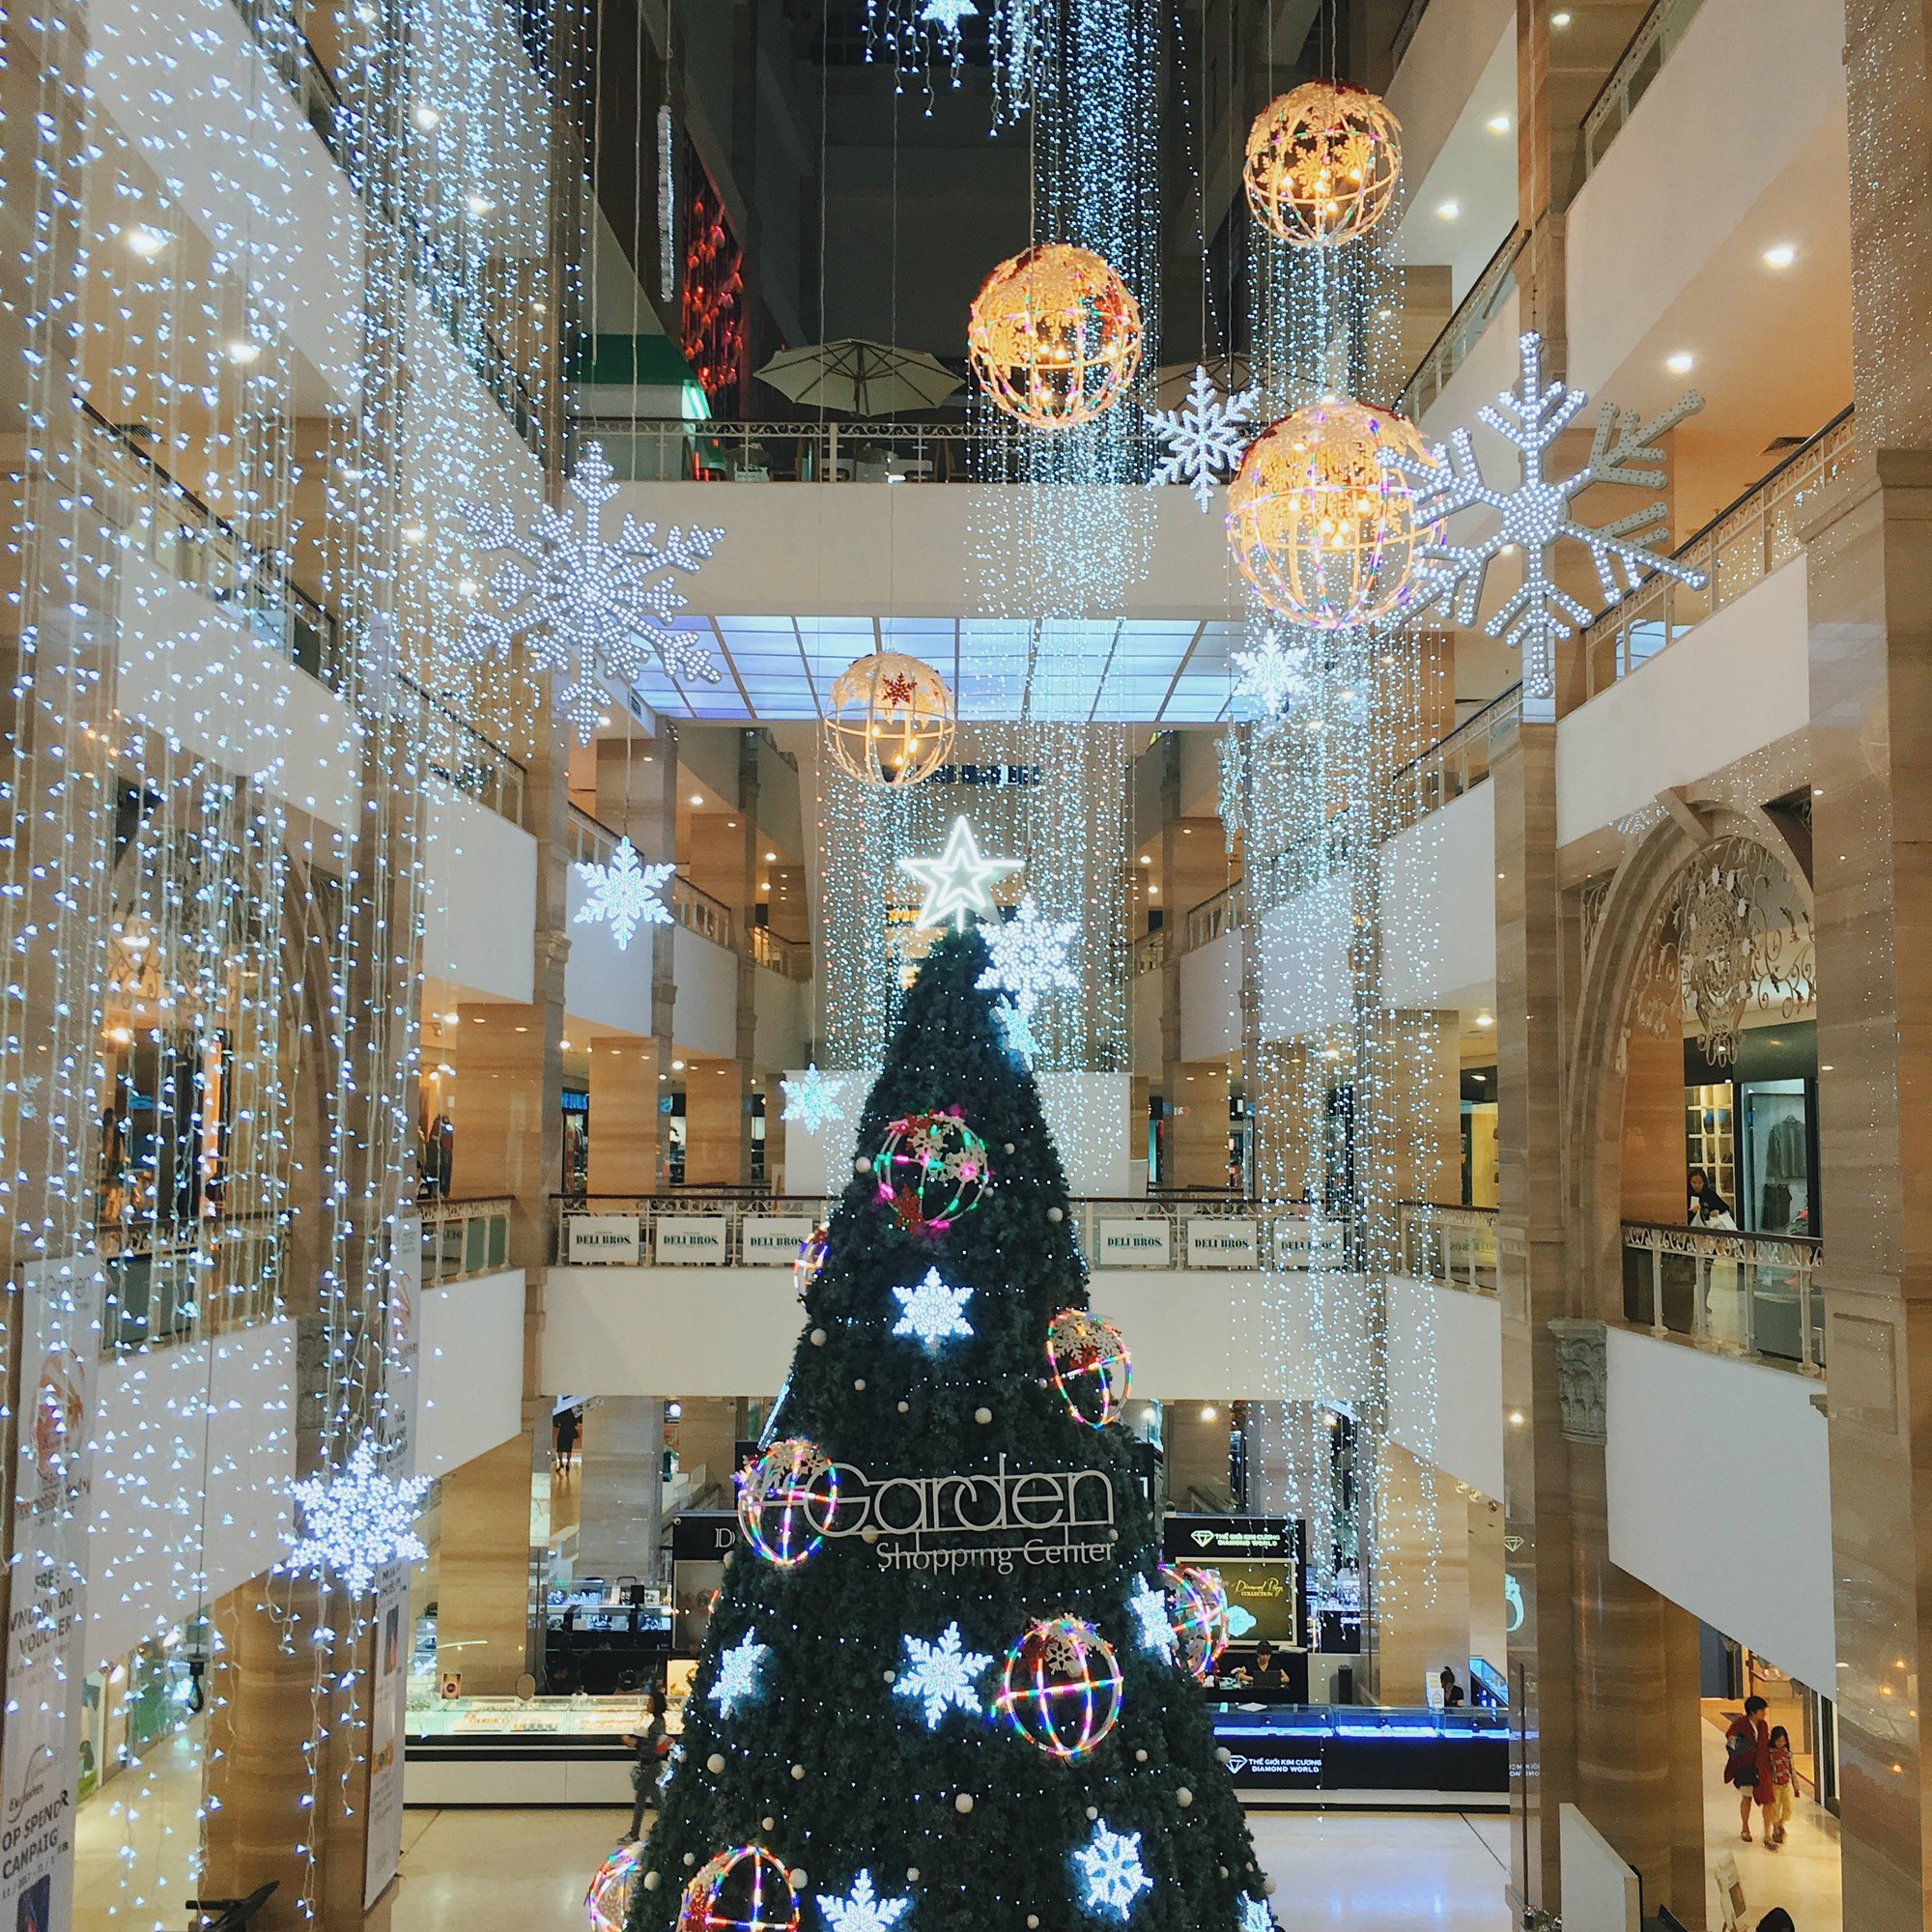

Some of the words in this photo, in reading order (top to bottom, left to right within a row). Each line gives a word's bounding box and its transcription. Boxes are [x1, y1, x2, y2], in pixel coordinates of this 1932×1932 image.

[576, 1236, 599, 1245] DELI
[602, 1236, 632, 1245] BROS.
[664, 1236, 686, 1245] DELI
[690, 1236, 719, 1245] BROS.
[750, 1236, 773, 1246] DELI
[1107, 1237, 1130, 1246] DELI
[1133, 1237, 1163, 1247] BROS.
[1195, 1238, 1217, 1248] DELI
[804, 1453, 1114, 1538] Garden
[876, 1542, 1013, 1575] Shopping
[1023, 1539, 1117, 1565] Center
[1248, 1757, 1264, 1766] THẾ
